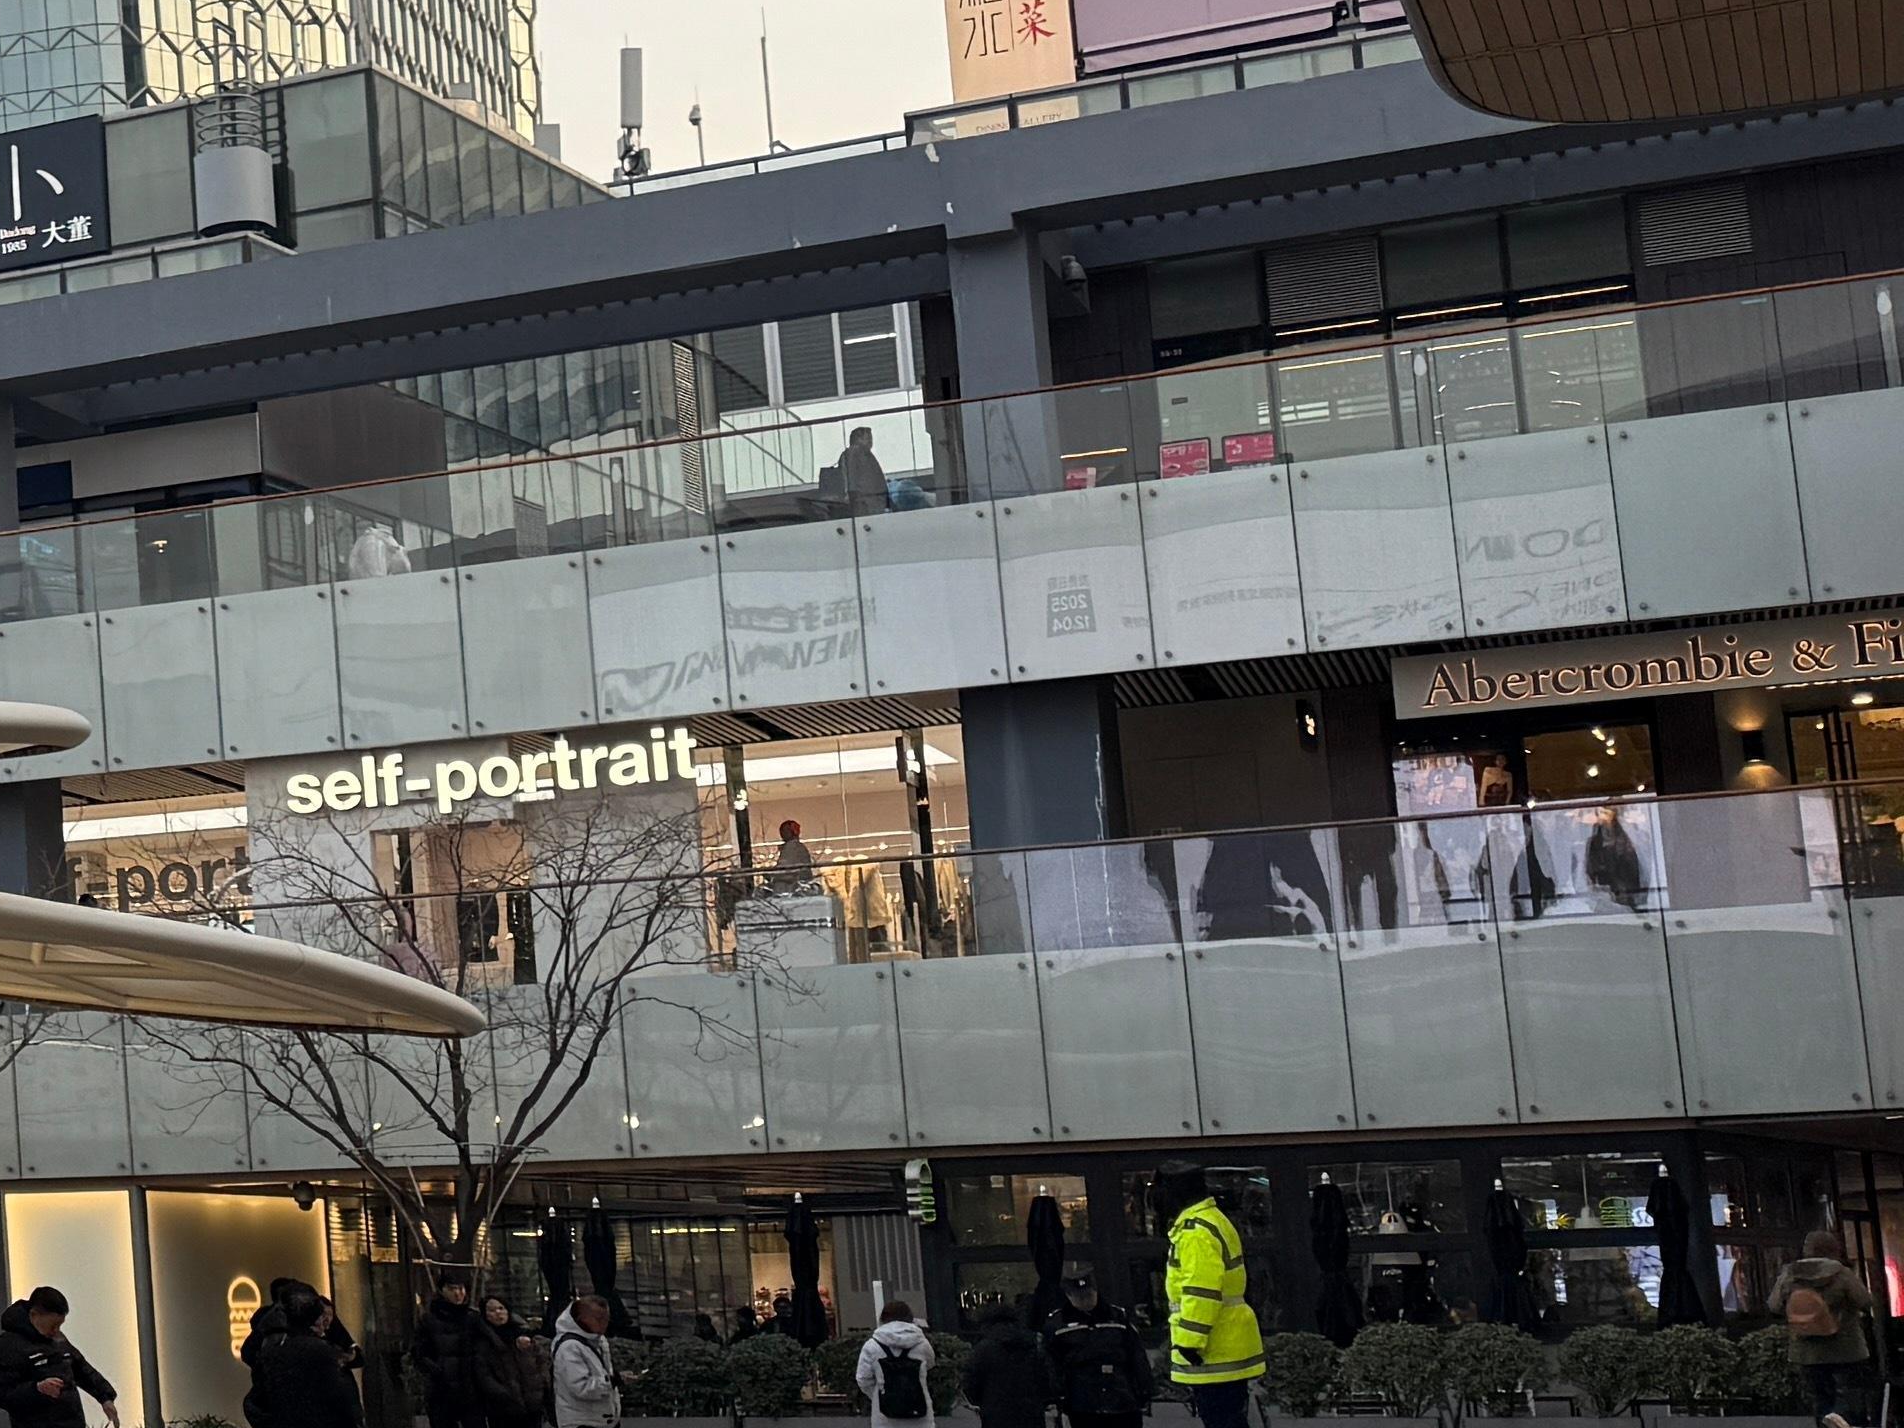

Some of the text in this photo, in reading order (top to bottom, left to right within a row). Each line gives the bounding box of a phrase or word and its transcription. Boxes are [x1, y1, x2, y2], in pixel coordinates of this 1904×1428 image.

[42, 215, 93, 249] 大董
[1422, 634, 1773, 709] Abercrombie
[1792, 638, 1837, 673] &
[286, 726, 698, 815] self-portrait
